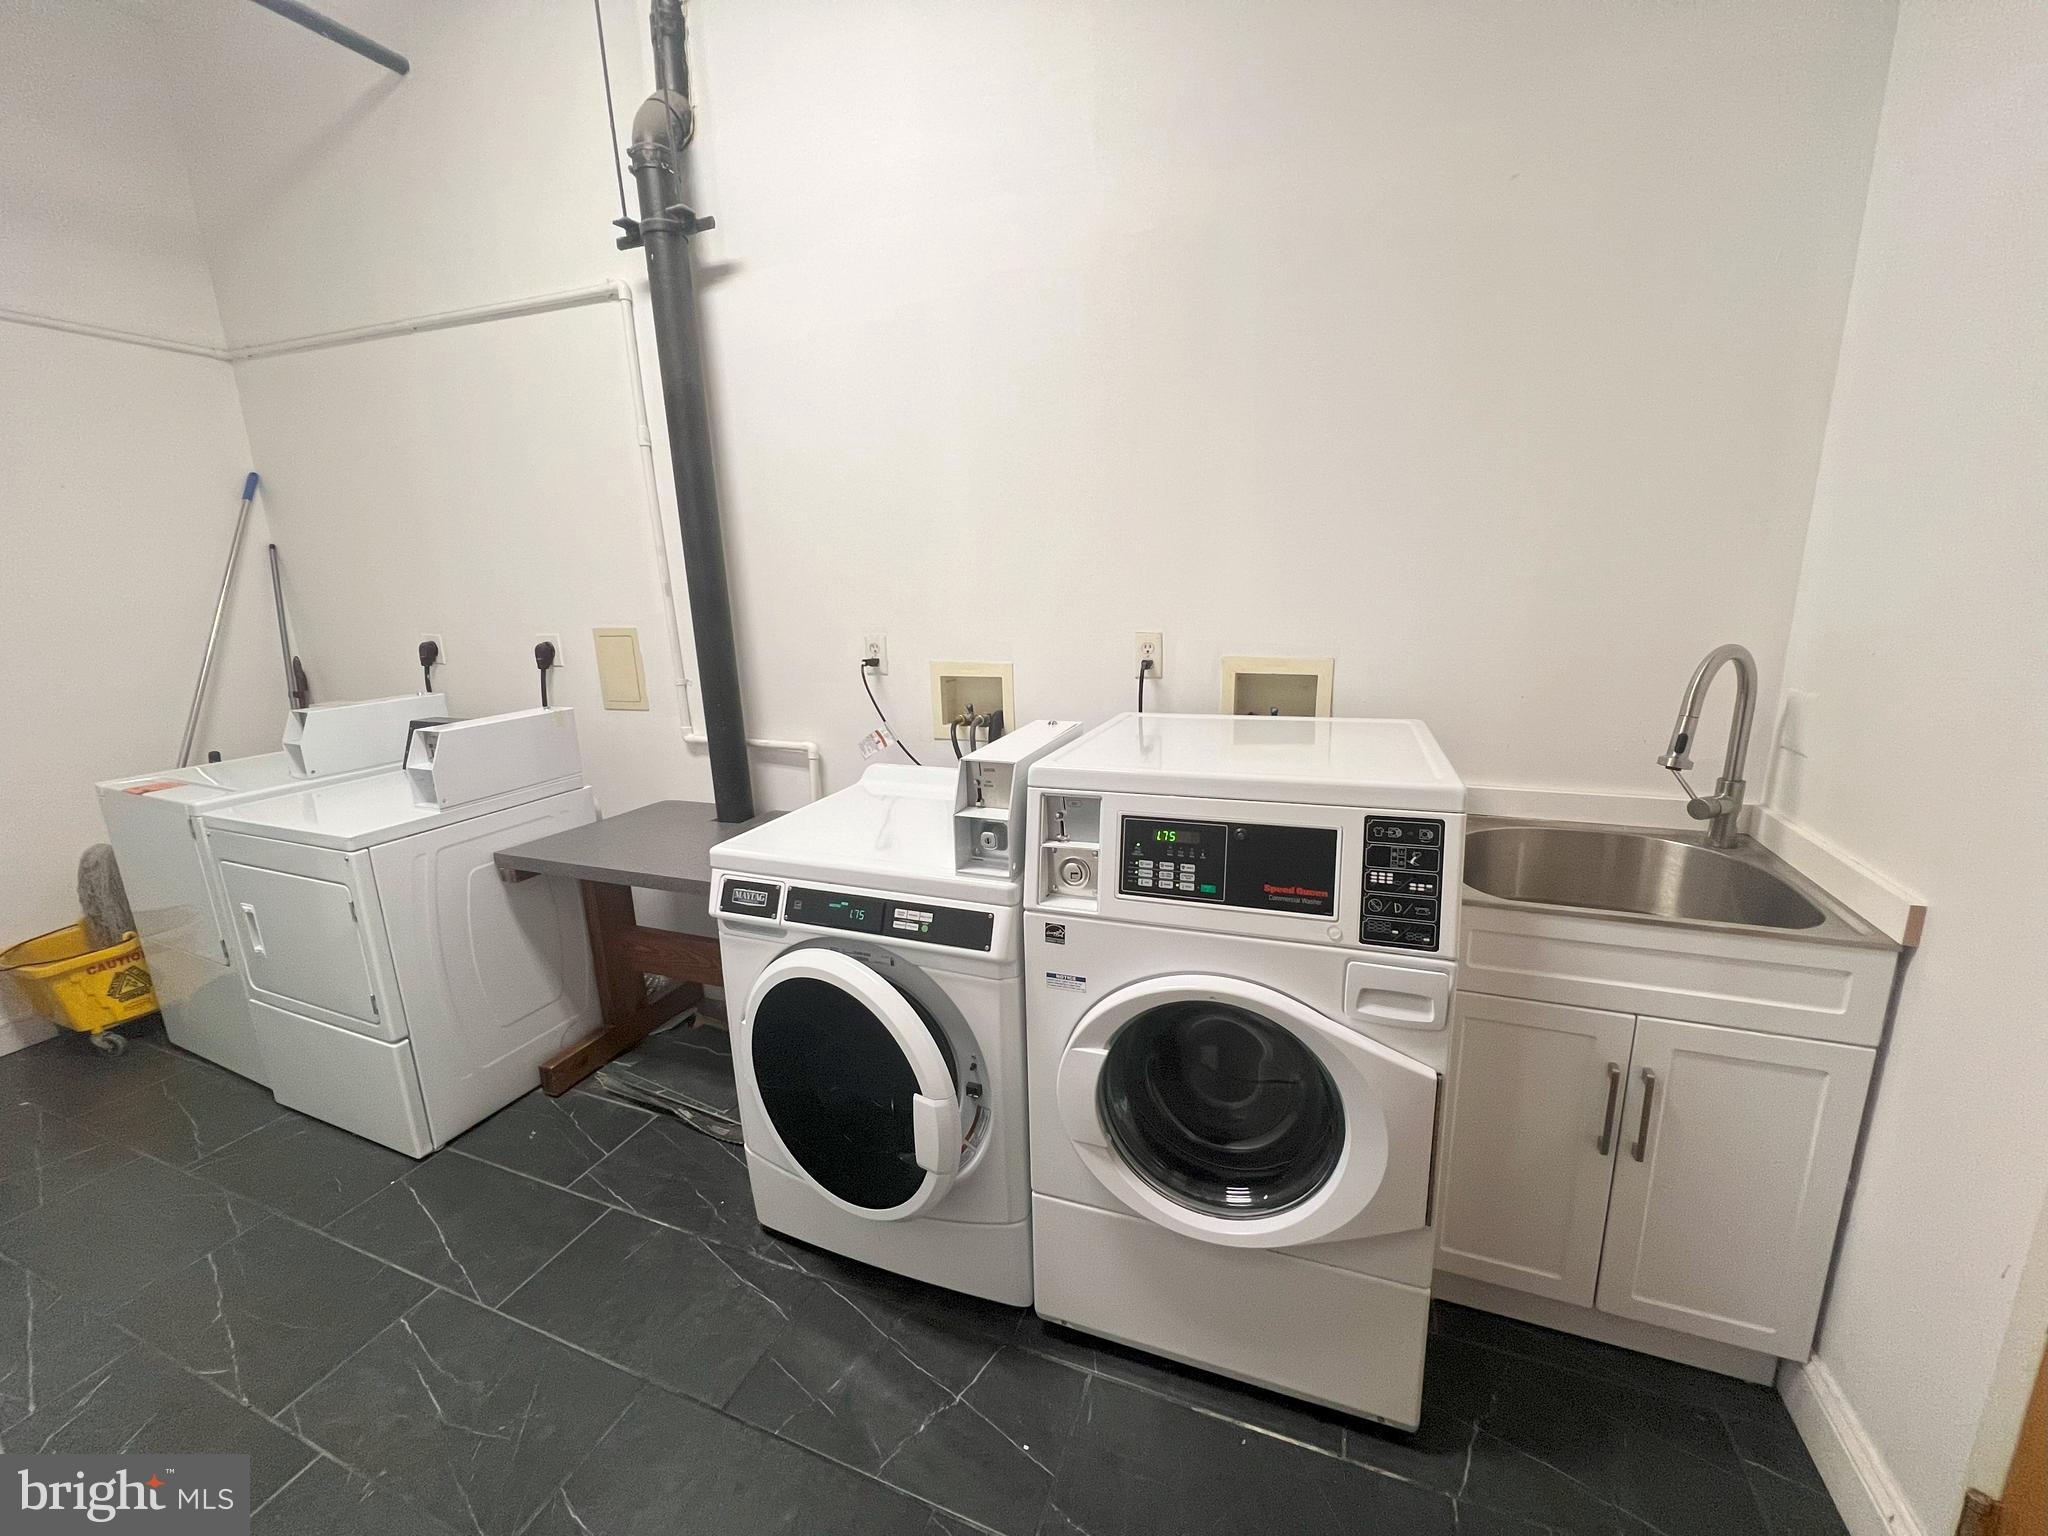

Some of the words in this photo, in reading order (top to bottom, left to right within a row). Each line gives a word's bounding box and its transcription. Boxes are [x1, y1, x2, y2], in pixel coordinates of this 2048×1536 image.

[734, 890, 765, 901] MAYTAG
[1263, 884, 1295, 894] Speed
[1296, 888, 1328, 897] Queen
